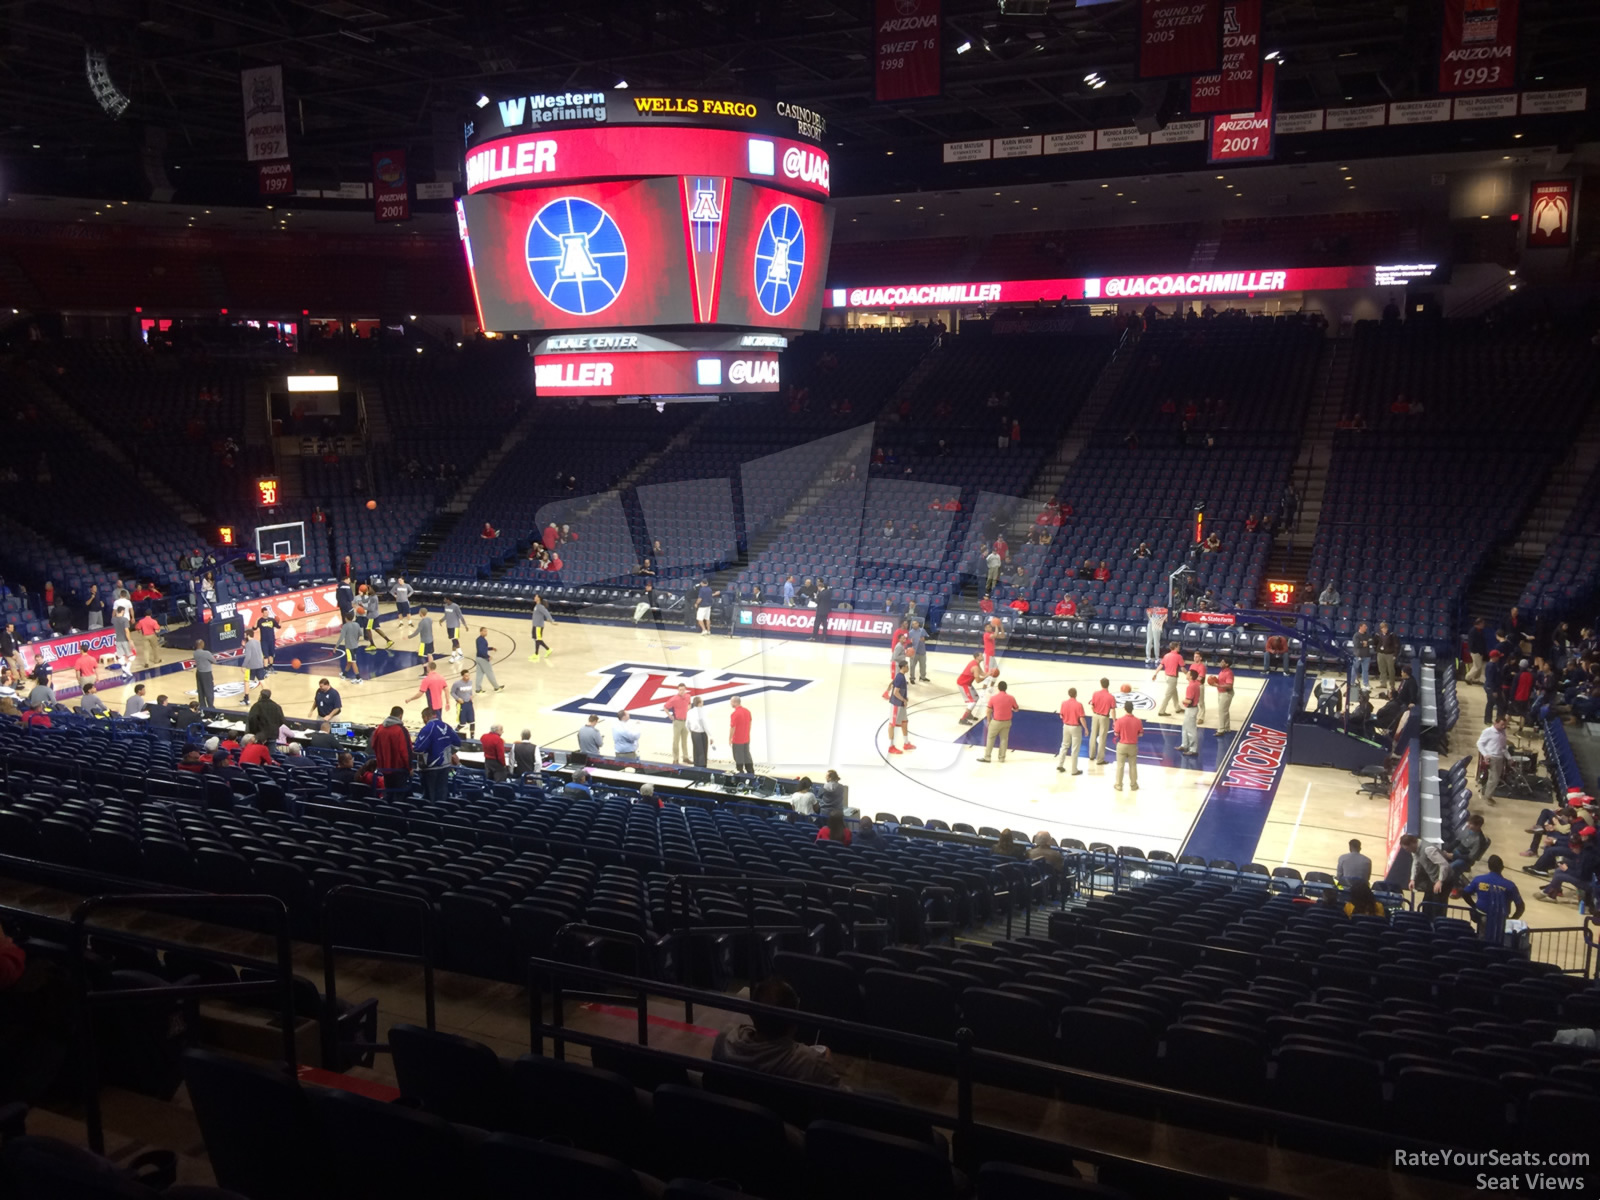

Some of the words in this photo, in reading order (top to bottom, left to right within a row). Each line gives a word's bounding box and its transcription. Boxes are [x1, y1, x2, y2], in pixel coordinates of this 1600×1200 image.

[1152, 6, 1189, 19] ROUND
[1191, 4, 1208, 14] OF
[879, 14, 937, 33] ARIZONA
[1154, 14, 1204, 28] SIXTEEN
[1145, 30, 1175, 44] 2005
[1223, 34, 1257, 48] ZONA
[880, 40, 918, 55] SWEET
[923, 38, 935, 49] 16
[1443, 45, 1512, 62] ARIZONA
[880, 57, 904, 70] 1998
[1227, 70, 1253, 81] 2002
[1453, 66, 1501, 86] 1993
[1195, 86, 1221, 97] 2005
[530, 92, 605, 110] Western
[634, 98, 699, 113] WELLS
[702, 99, 757, 118] FARGO
[498, 97, 527, 128] W
[531, 106, 607, 122] Refining
[776, 102, 811, 124] CASINO
[248, 124, 284, 137] ARIZONA
[798, 120, 821, 142] RESORT
[1215, 118, 1269, 132] ARIZONA
[254, 141, 280, 156] 1997
[1220, 137, 1260, 153] 2001
[260, 164, 291, 176] ARIZONA
[265, 178, 288, 192] 1997
[377, 193, 408, 203] ARIZONA
[381, 206, 404, 218] 2001
[691, 190, 722, 222] A
[1105, 271, 1287, 297] @UACOACHMILLER
[850, 284, 1002, 307] @UACOACHMILLER
[589, 335, 638, 348] CENTER
[263, 489, 275, 503] 30
[1275, 592, 1288, 604] 30
[1222, 723, 1289, 792] ARIZONA
